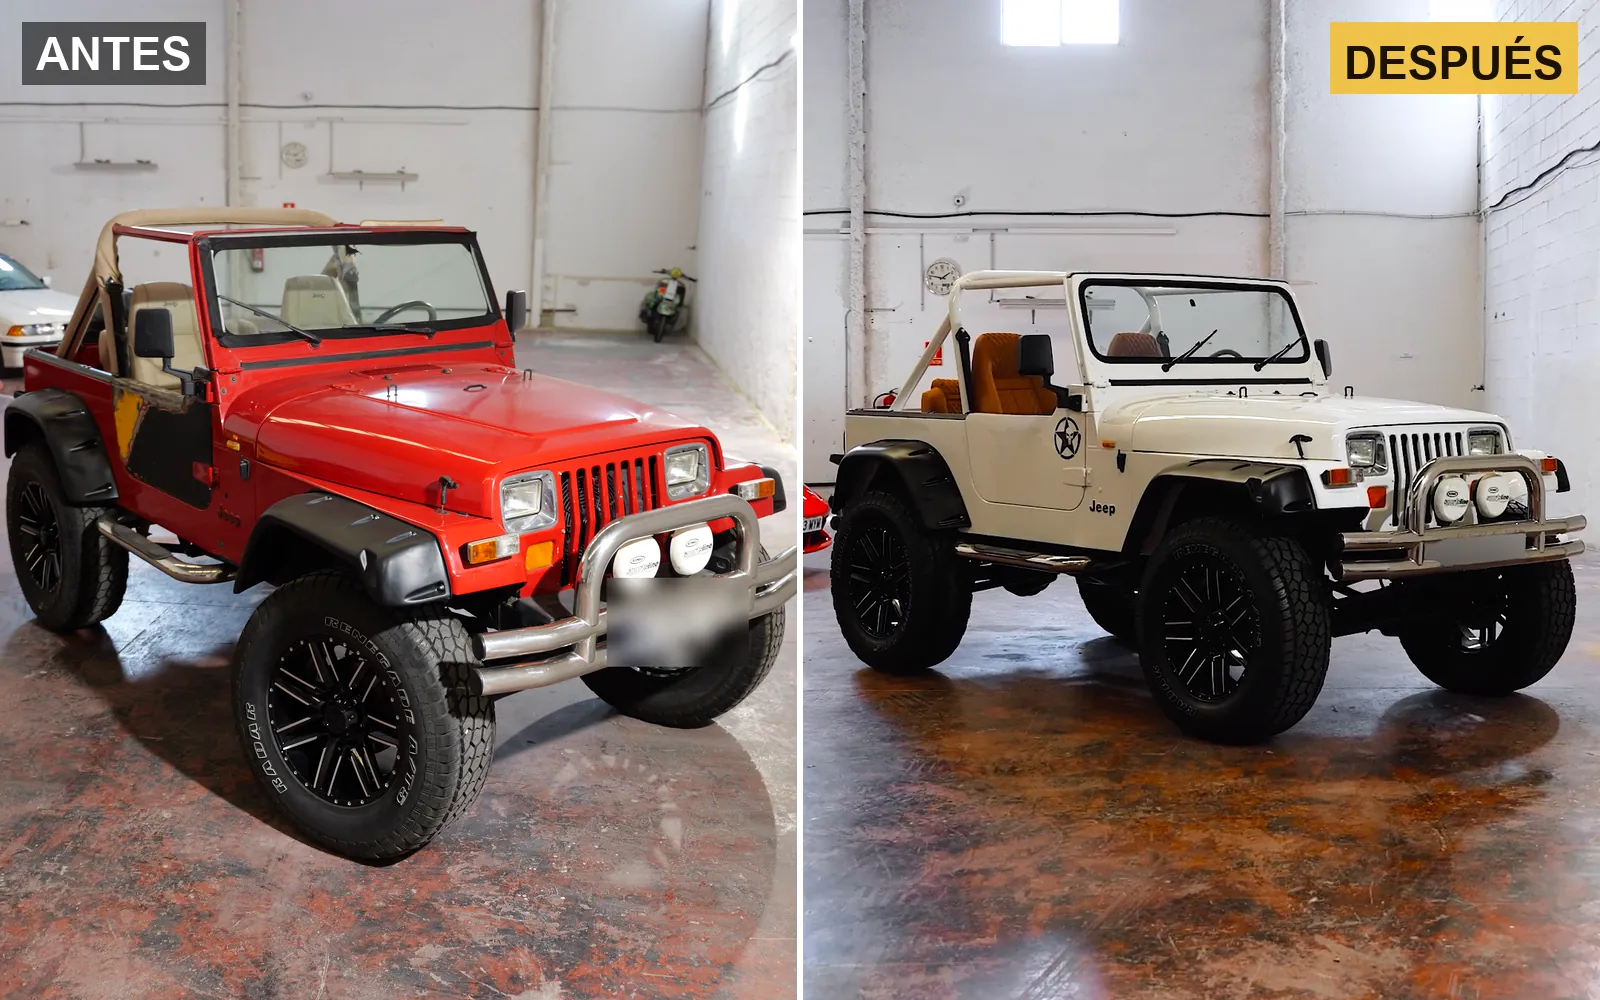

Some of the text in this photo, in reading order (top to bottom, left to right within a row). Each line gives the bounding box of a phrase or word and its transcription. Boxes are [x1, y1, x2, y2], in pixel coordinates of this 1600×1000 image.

[1089, 500, 1116, 516] Jeep
[324, 616, 415, 725] RENEGADE
[244, 702, 288, 794] RADAR
